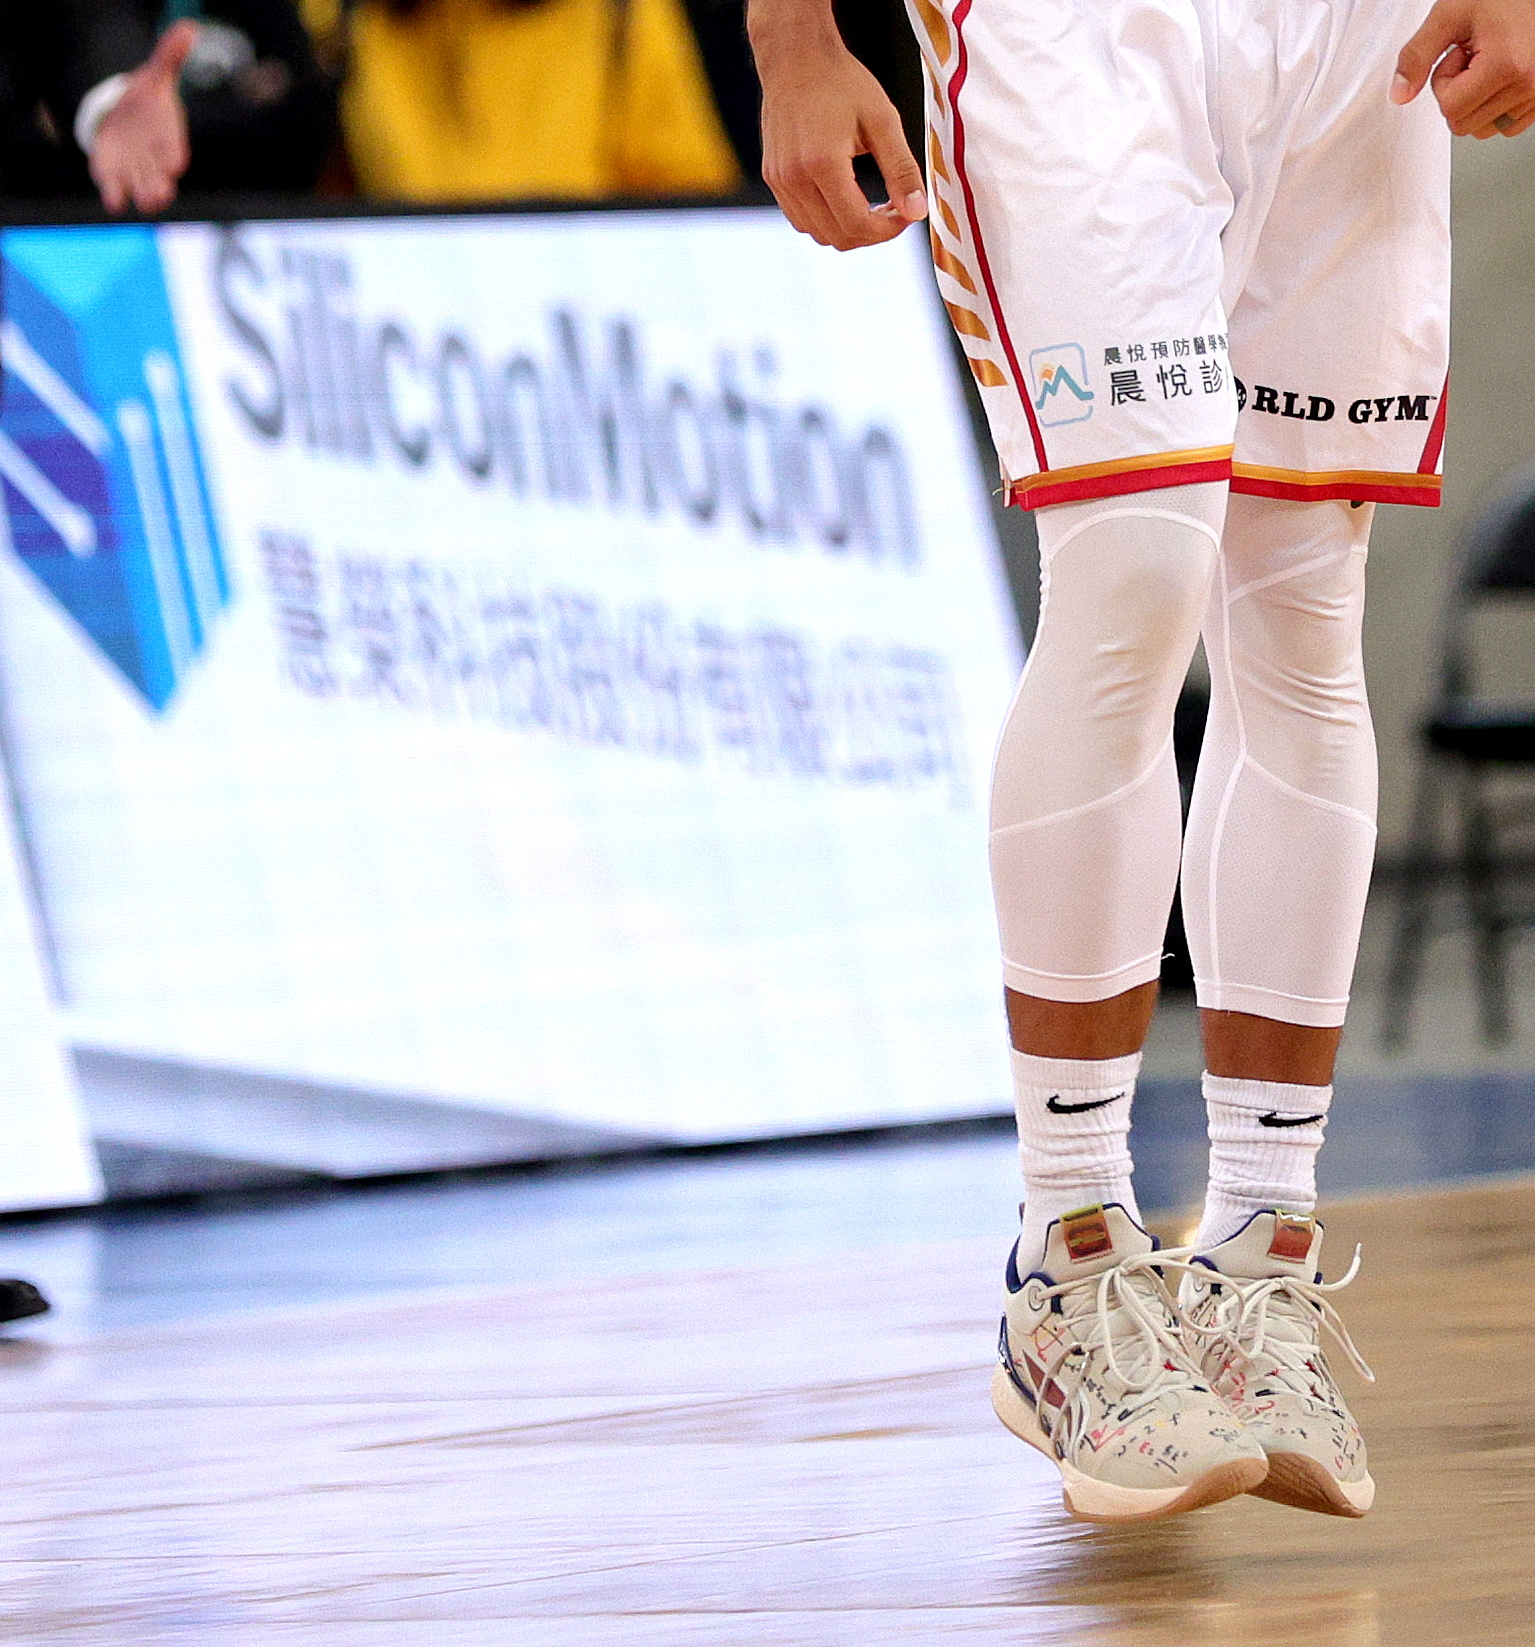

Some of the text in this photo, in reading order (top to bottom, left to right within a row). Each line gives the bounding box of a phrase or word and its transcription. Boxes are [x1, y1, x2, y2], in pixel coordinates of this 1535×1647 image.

[1109, 358, 1229, 407] 晨悅診
[1234, 376, 1336, 422] RLD
